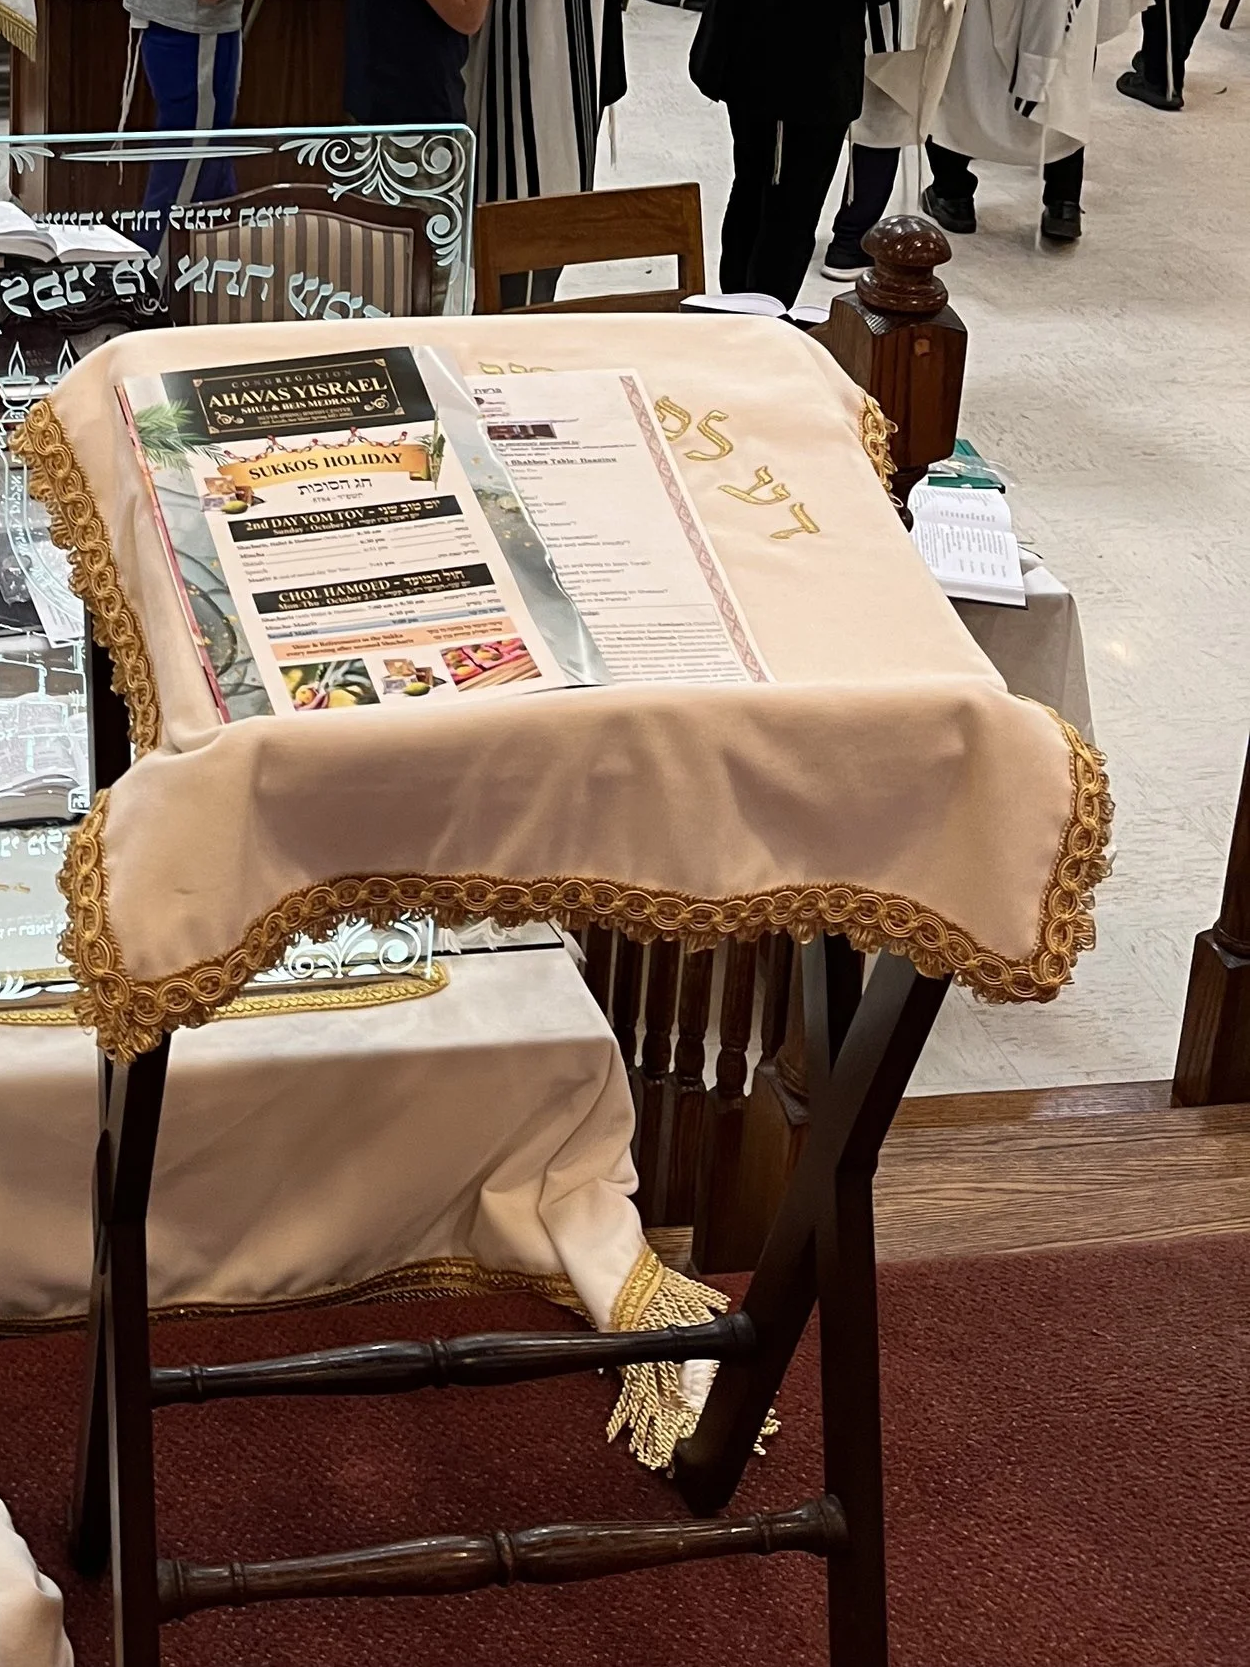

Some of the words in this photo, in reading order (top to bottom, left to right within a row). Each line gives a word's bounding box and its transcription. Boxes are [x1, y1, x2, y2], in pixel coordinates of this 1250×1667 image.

[230, 369, 353, 389] CONGREGATION
[208, 385, 292, 409] AHAVAS
[292, 377, 388, 400] YISRAEL
[240, 403, 271, 416] SHUL
[309, 395, 362, 410] MEDRASH
[248, 458, 319, 481] SUKKOS
[325, 451, 403, 470] HOLIDAY
[297, 480, 351, 497] הסוכות
[355, 477, 373, 491] חג
[377, 503, 399, 516] שני
[401, 501, 422, 514] טוב
[424, 498, 441, 511] יום
[300, 510, 334, 526] YOM
[336, 507, 365, 522] TOV
[244, 518, 269, 532] 2nd
[271, 514, 299, 530] DAY
[273, 523, 304, 536] Sunday
[309, 517, 346, 532] October
[403, 573, 441, 587] המועד
[442, 568, 465, 582] חול
[278, 589, 322, 603] CHOL
[326, 594, 362, 605] October
